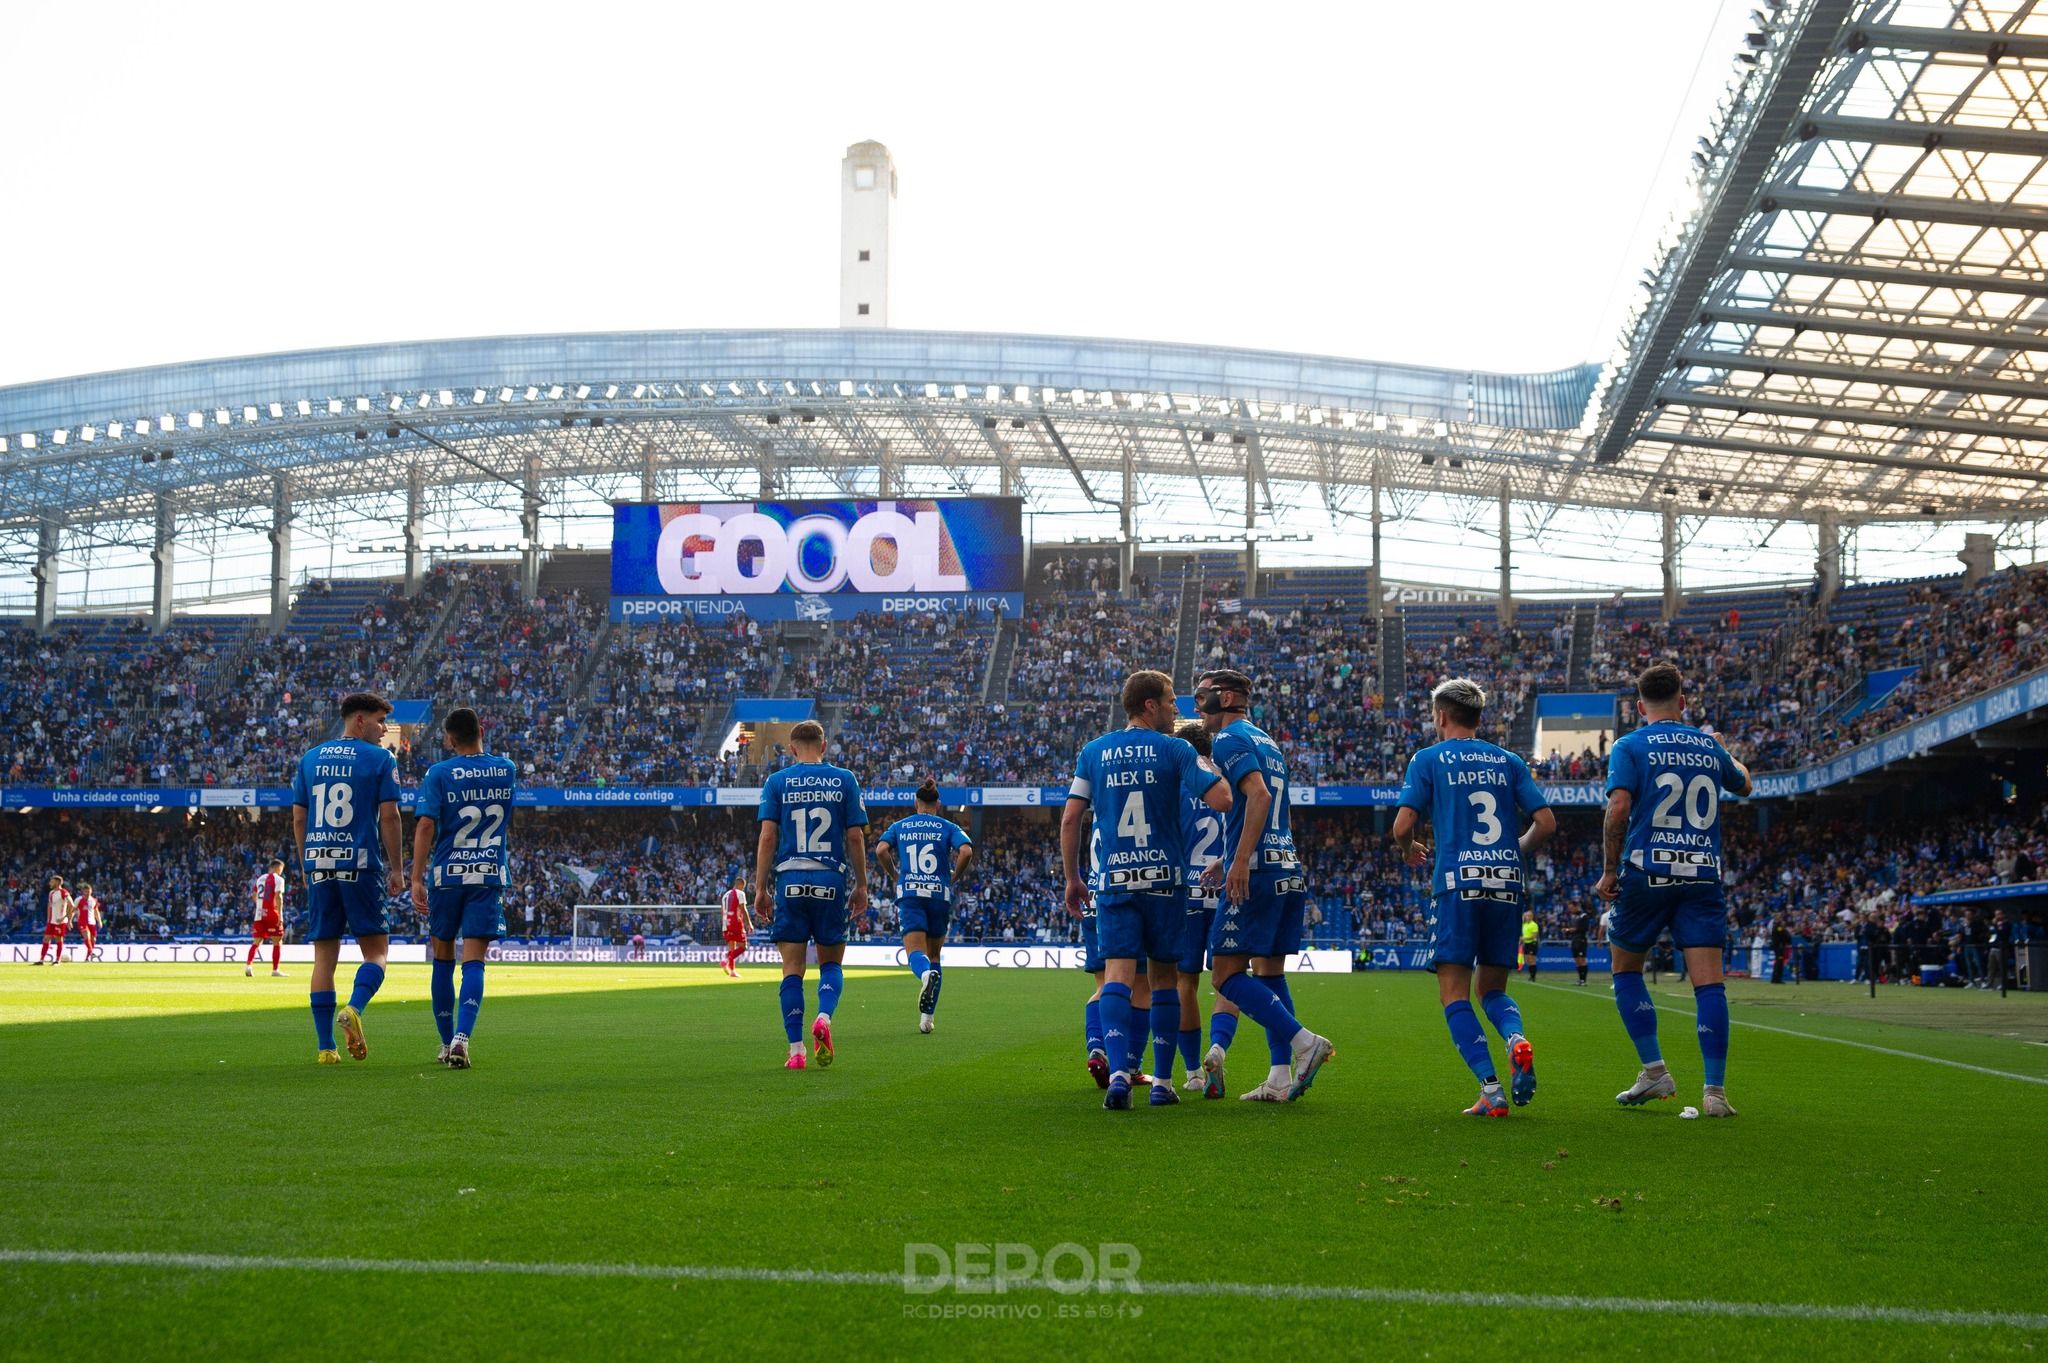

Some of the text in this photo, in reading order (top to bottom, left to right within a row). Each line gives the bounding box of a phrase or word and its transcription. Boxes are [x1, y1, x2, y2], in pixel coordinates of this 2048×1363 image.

[656, 511, 966, 594] GOOOL
[622, 600, 745, 615] DEPORTIENDA
[1647, 732, 1714, 749] PELICANO
[319, 746, 357, 755] PROEL
[1101, 745, 1157, 762] MASTIL
[1460, 752, 1507, 764] kotablue
[1265, 754, 1285, 775] LUCAS
[1648, 751, 1720, 771] SVENSSON
[315, 765, 352, 777] TRILLI
[452, 766, 507, 780] Debullar
[1106, 769, 1157, 788] ALEX B.
[1448, 769, 1507, 786] LAPEÑA
[785, 776, 841, 788] PELICANO
[53, 791, 160, 804] Unha cidade contigo
[447, 792, 459, 803] D.
[461, 788, 511, 802] VILLARES
[564, 790, 674, 803] Unha cidade contigo
[782, 790, 843, 804] LEBEDENKO
[1270, 776, 1284, 829] 7
[1652, 772, 1718, 830] 20
[312, 783, 353, 828] 18
[454, 804, 504, 848] 22
[902, 820, 942, 829] PELICANO
[1117, 791, 1151, 847] 4
[1468, 791, 1502, 846] 3
[791, 807, 832, 853] 12
[900, 832, 942, 841] MARTINEZ
[305, 848, 353, 861] DIGI
[906, 843, 938, 874] 16
[1652, 848, 1715, 868] DIGI
[447, 862, 499, 876] DIGI
[1109, 866, 1171, 887] DIGI
[1460, 865, 1520, 883] DIGI
[785, 884, 836, 900] DIGI
[905, 882, 942, 892] DIGI
